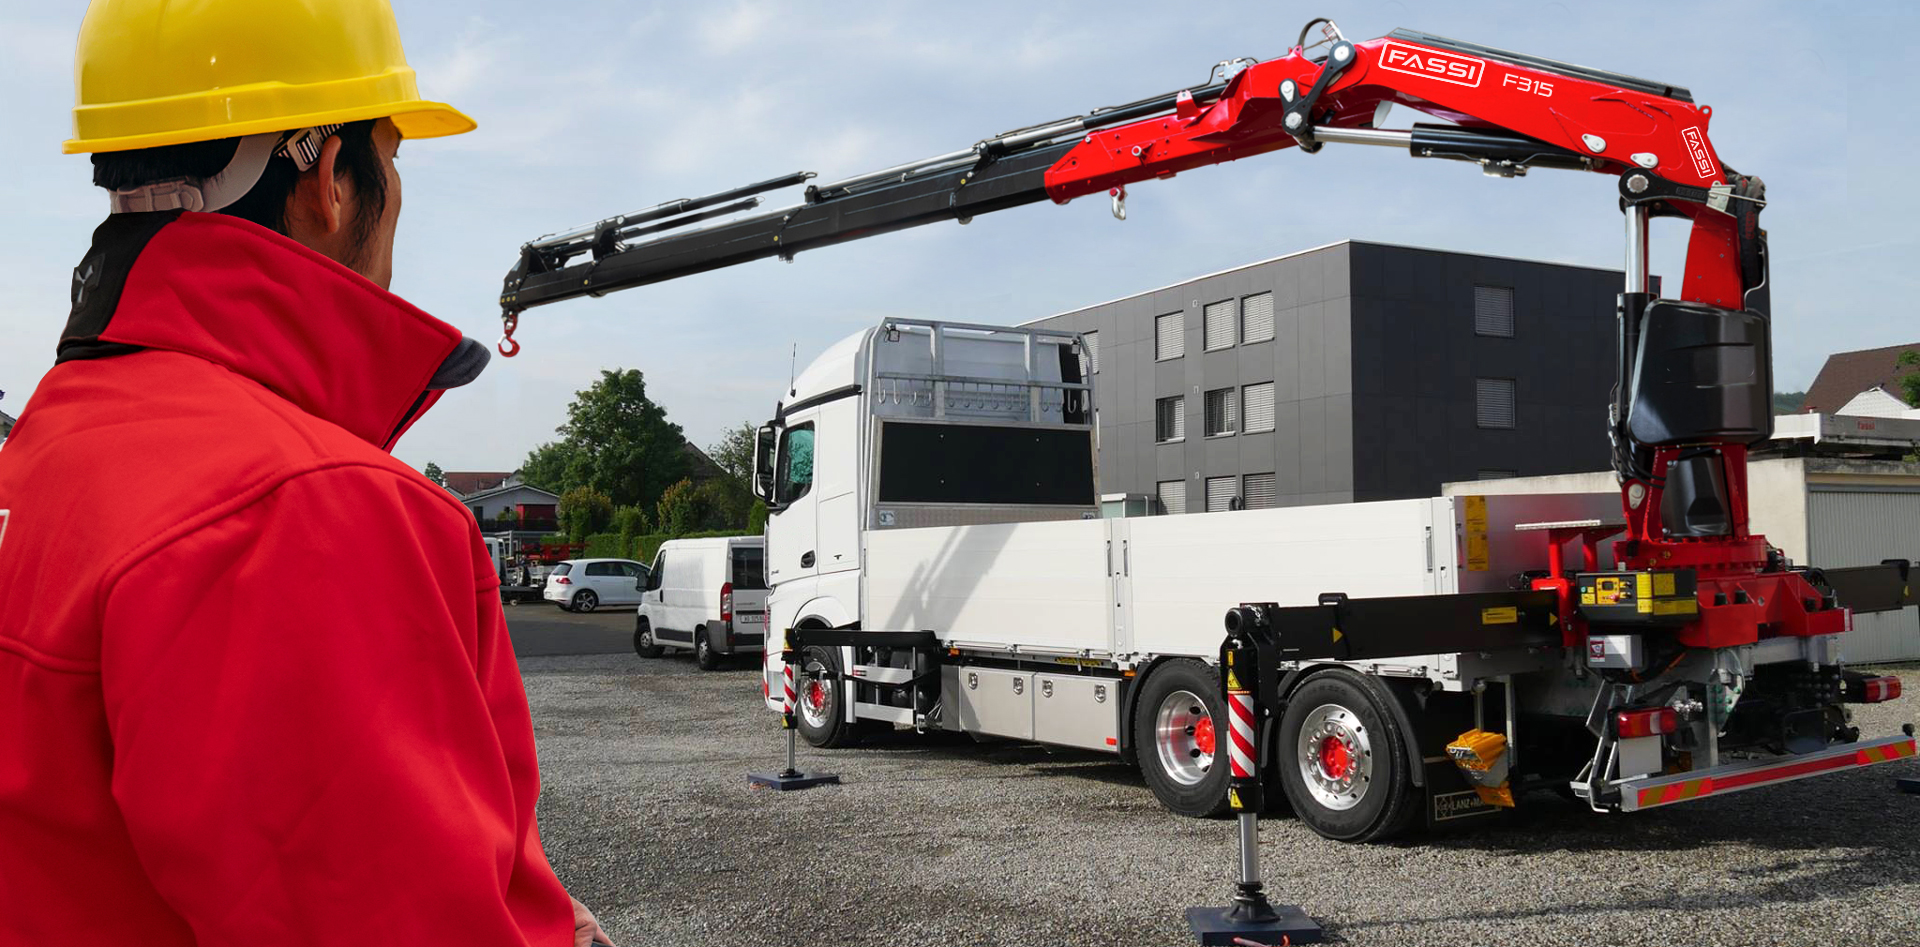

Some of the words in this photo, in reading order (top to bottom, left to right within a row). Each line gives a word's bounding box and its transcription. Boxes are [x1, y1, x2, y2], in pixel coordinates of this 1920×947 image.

[1387, 49, 1476, 80] FASSI
[1502, 73, 1554, 98] F315
[1686, 131, 1711, 174] FASSI
